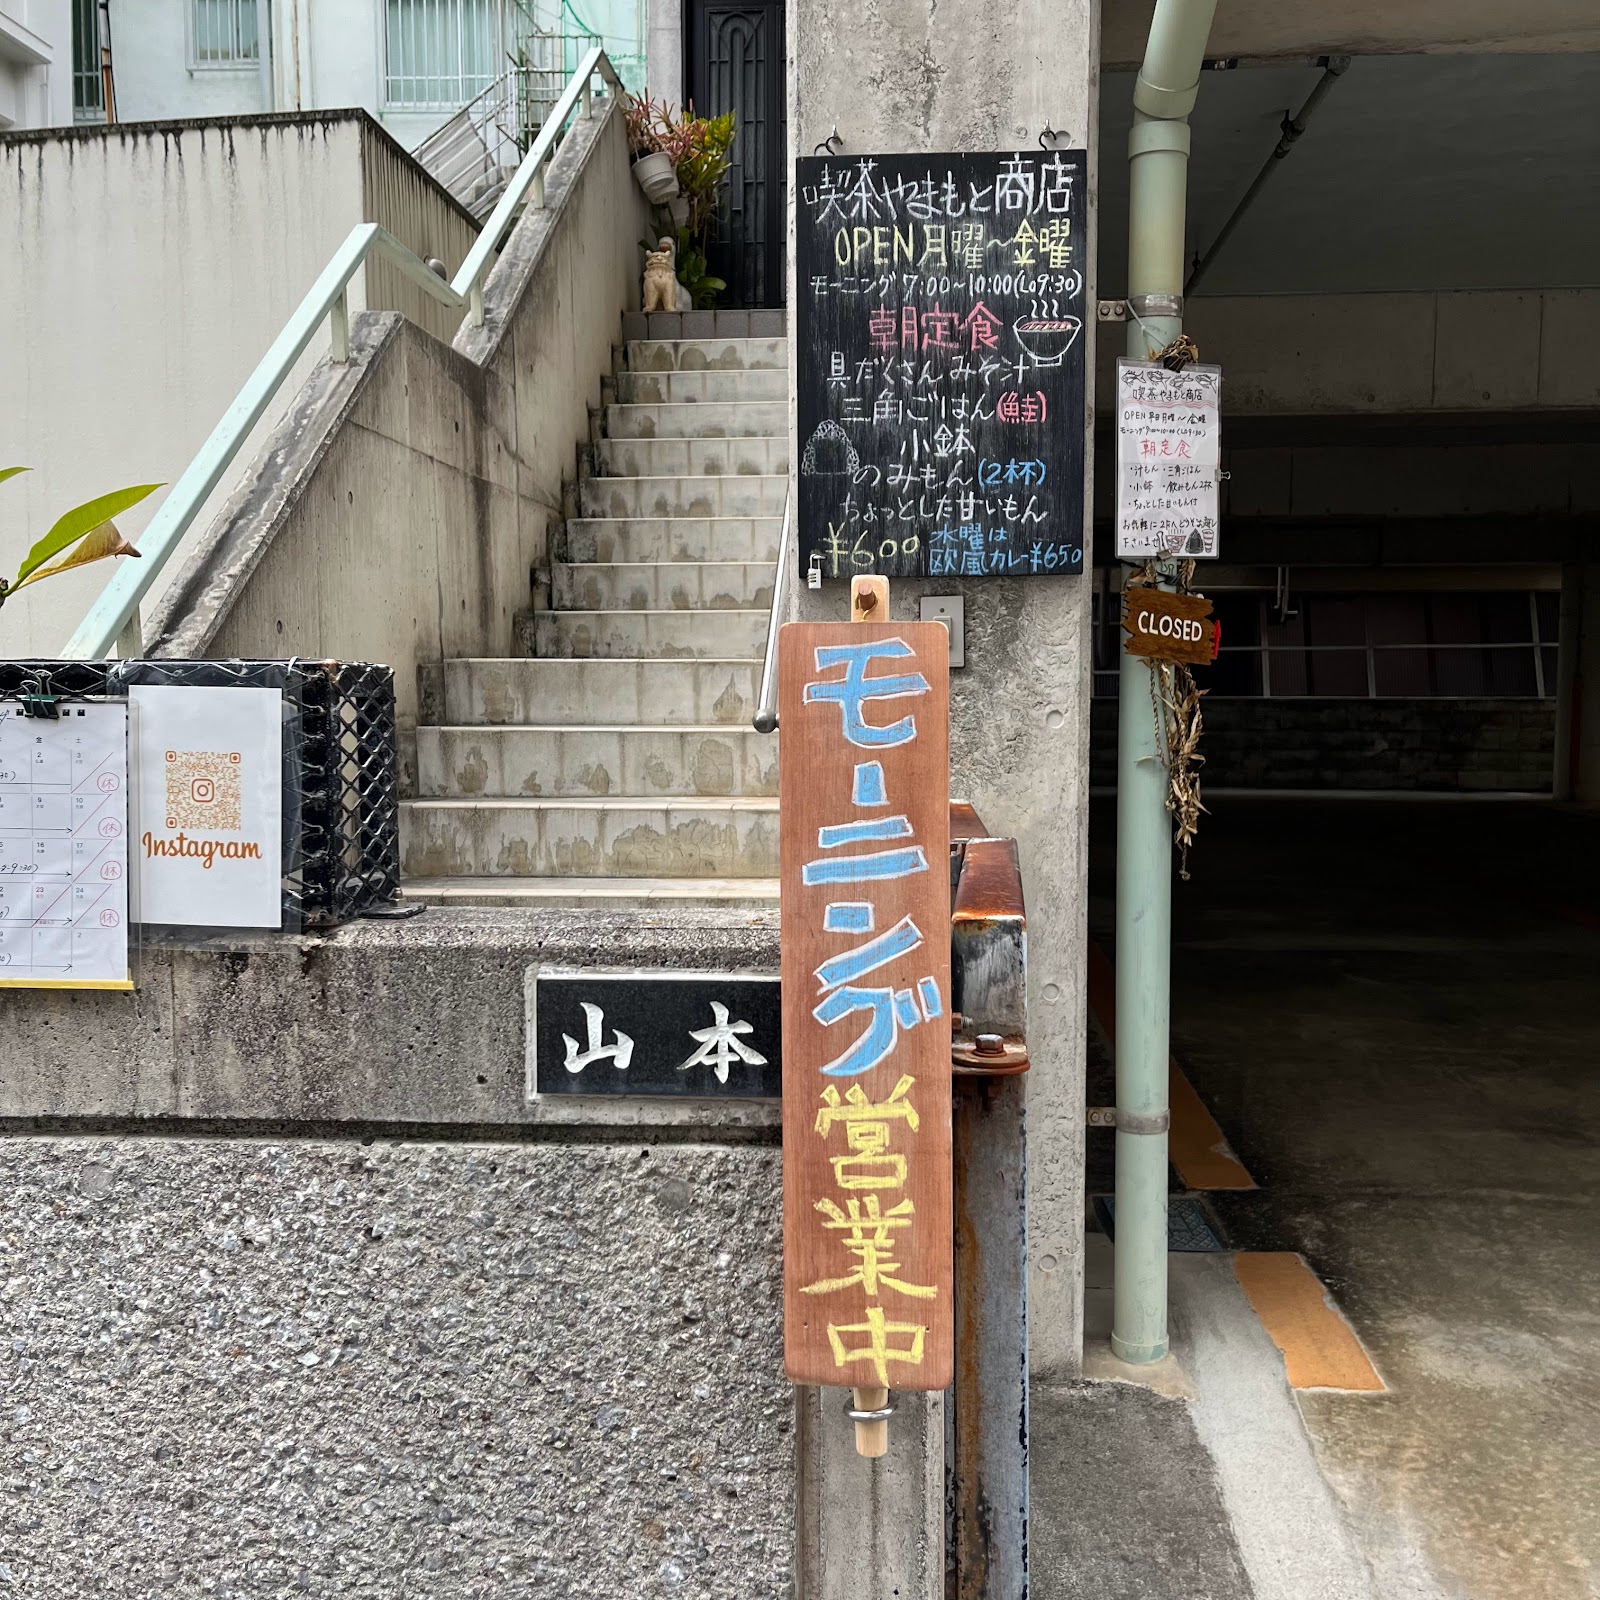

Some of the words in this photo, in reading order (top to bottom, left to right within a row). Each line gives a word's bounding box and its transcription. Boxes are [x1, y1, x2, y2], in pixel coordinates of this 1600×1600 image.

[802, 152, 1078, 224] 喫茶やまもと商店
[834, 223, 914, 266] OPEN
[809, 270, 896, 297] モーニング
[868, 300, 1003, 351] 朝定食
[826, 351, 943, 388] 具だくさん
[949, 354, 1030, 386] みそ汁
[1132, 385, 1203, 402] 喫茶やまもと商店
[1124, 410, 1146, 421] OPEN
[900, 423, 976, 461] 小鉢
[1140, 438, 1192, 459] 朝定食
[840, 491, 1049, 523] ちょっとした甘いもん
[824, 522, 920, 578] ¥600
[929, 523, 1008, 551] 水曜は
[1137, 610, 1203, 642] CLOSED
[142, 831, 263, 869] Instagram
[561, 1000, 768, 1084] 山本
